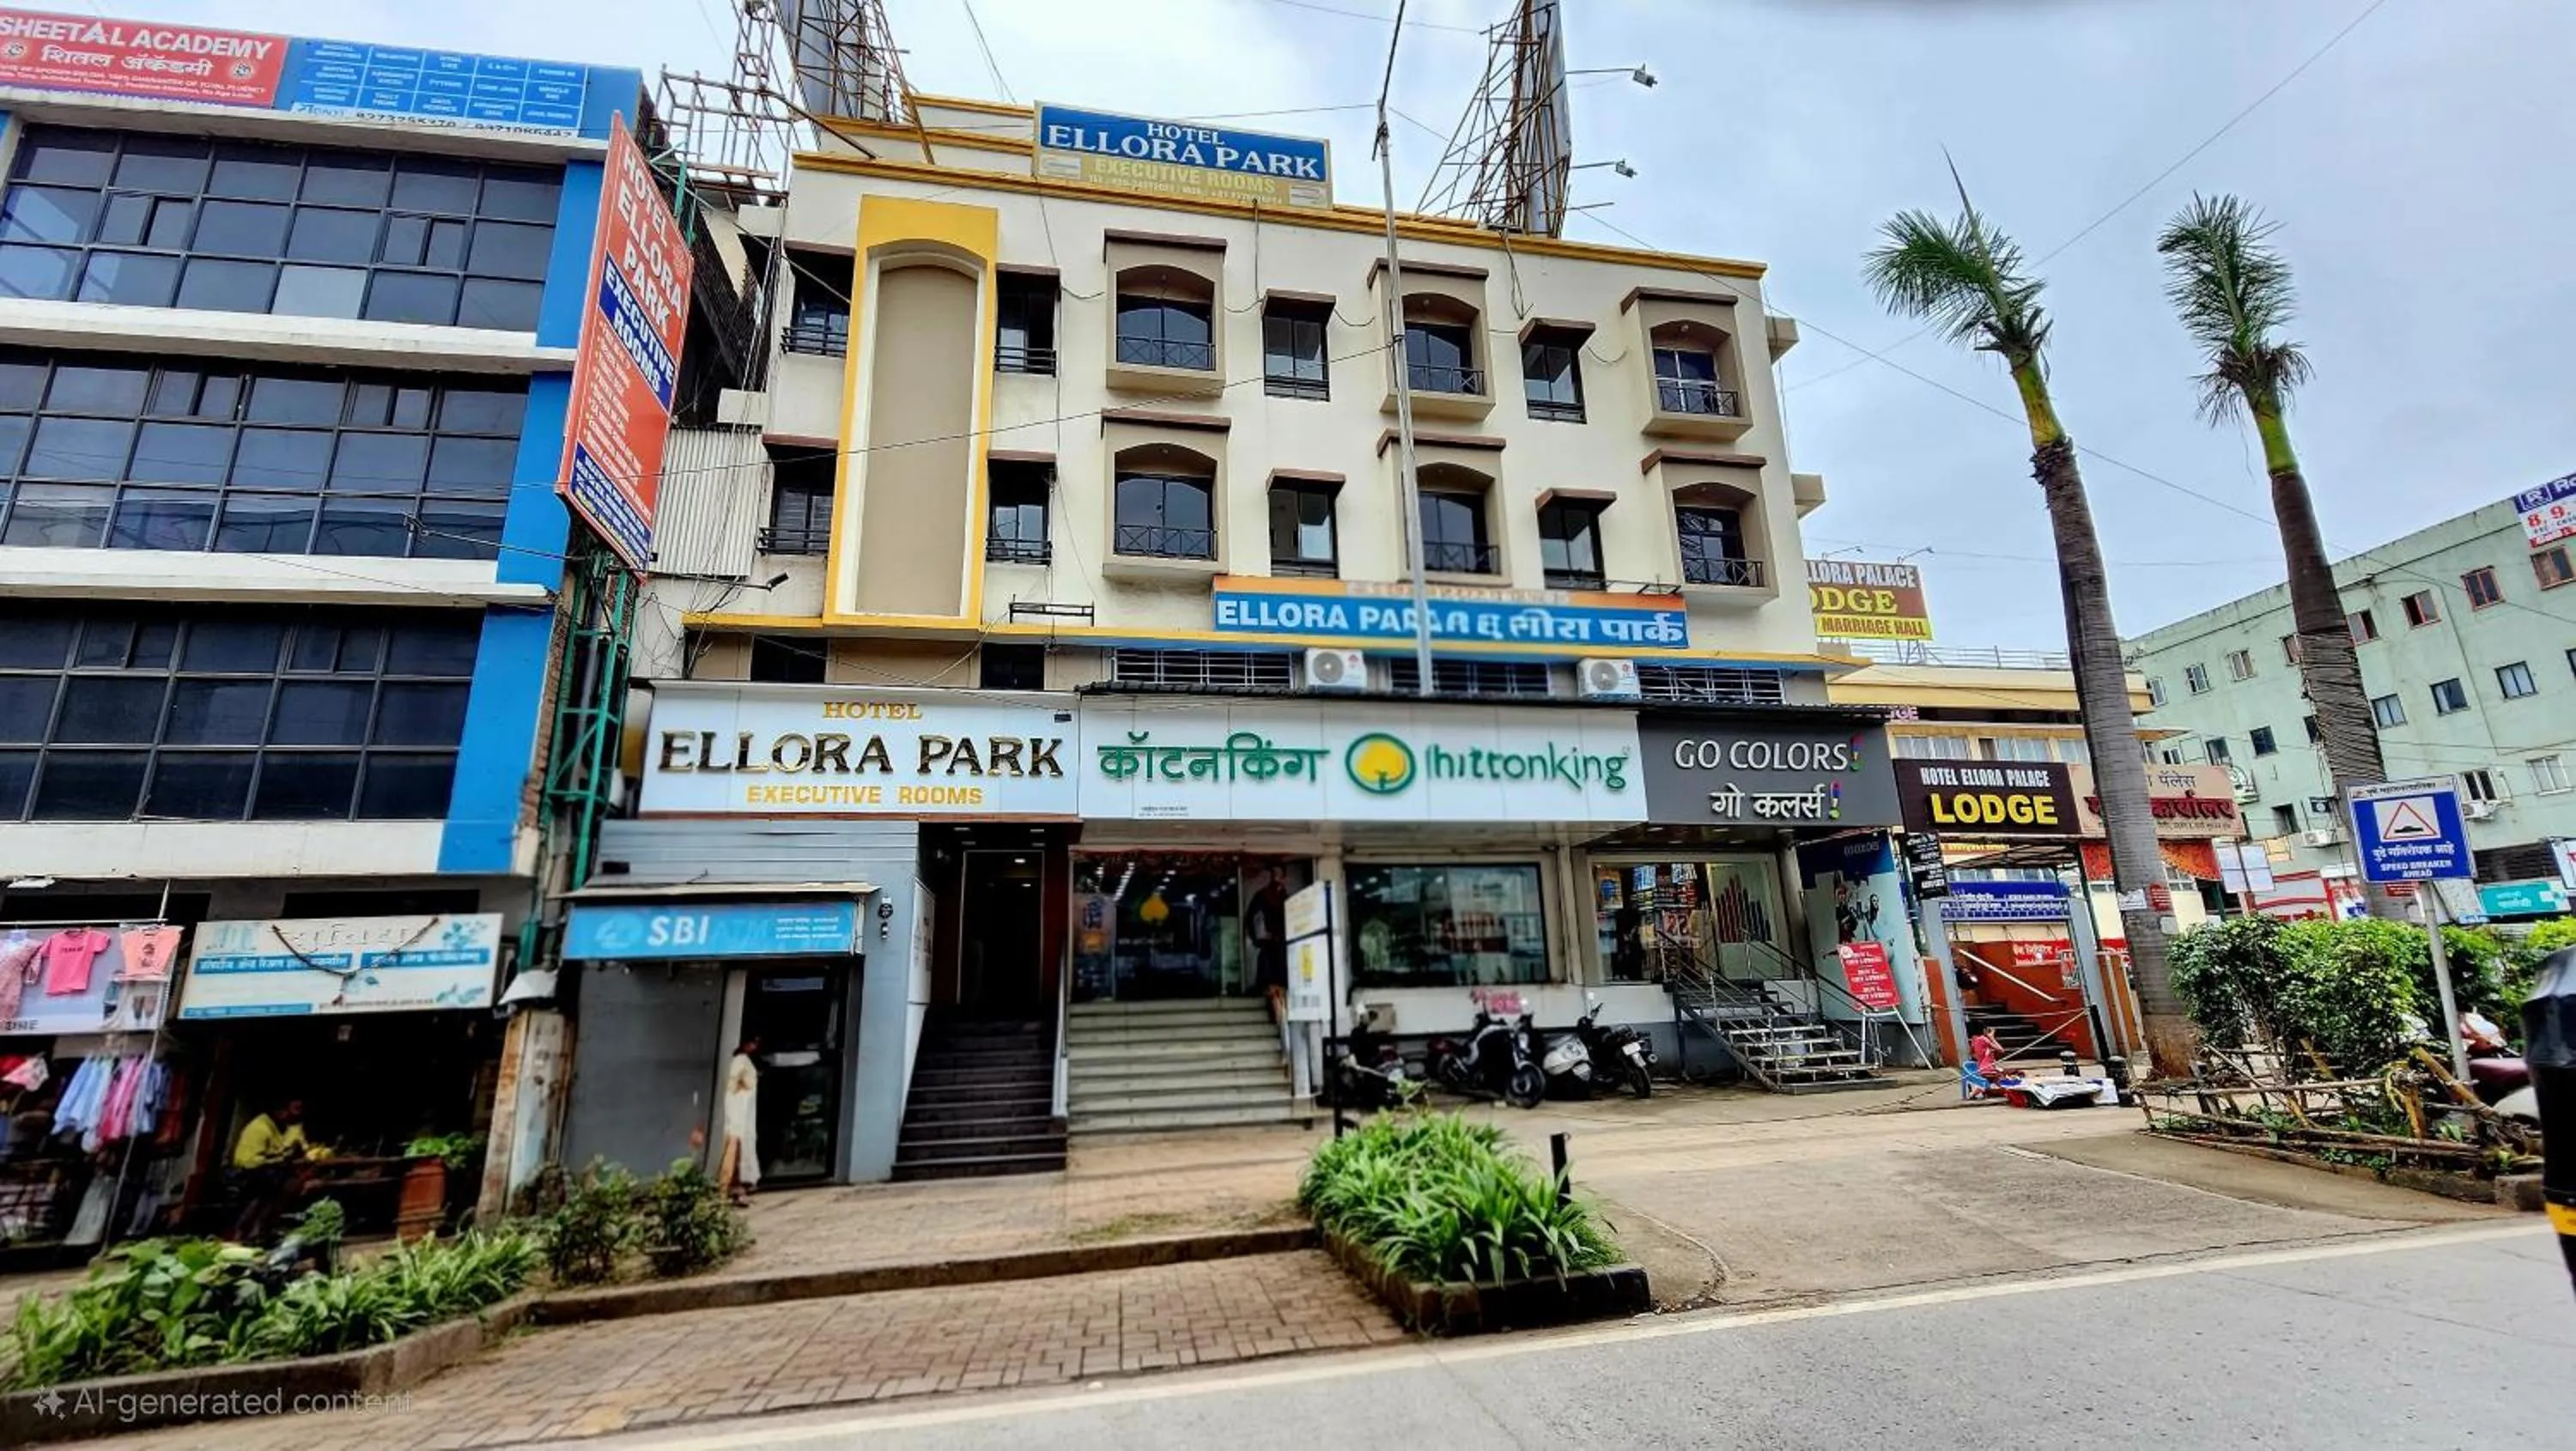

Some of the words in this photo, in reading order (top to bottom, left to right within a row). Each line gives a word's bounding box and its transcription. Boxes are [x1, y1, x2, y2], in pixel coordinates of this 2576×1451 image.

[130, 28, 272, 60] ACADEMY
[1147, 123, 1225, 146] HOTEL
[1047, 124, 1206, 166] ELLORA
[1216, 147, 1320, 179] PARK
[1094, 157, 1200, 185] EXECUTIVE
[1207, 172, 1276, 194] ROOMS
[623, 144, 667, 248] HOTEL
[617, 178, 682, 319] ELLORA
[623, 238, 670, 337] PARK
[605, 259, 674, 384] EXECUTIVE
[613, 307, 661, 394] ROOMS
[1855, 564, 1917, 588] PALACE
[1217, 600, 1348, 631] ELLORA
[1599, 612, 1684, 642] पार्क
[1822, 617, 1893, 634] MARRIAGE
[823, 701, 923, 720] HOTEL
[658, 731, 894, 775] ELLORA
[918, 736, 1068, 777] PARK
[1097, 731, 1330, 784] कॉटनकिंग
[1675, 739, 1721, 769] GO
[1920, 767, 1959, 786] HOTEL
[1960, 768, 2004, 786] ELLORA
[2006, 769, 2050, 787] PALACE
[746, 785, 882, 804] EXECUTIVE
[898, 786, 984, 805] ROOMS
[1710, 782, 1745, 818] गो
[1930, 793, 2058, 825] LODGE
[647, 914, 710, 947] SBI
